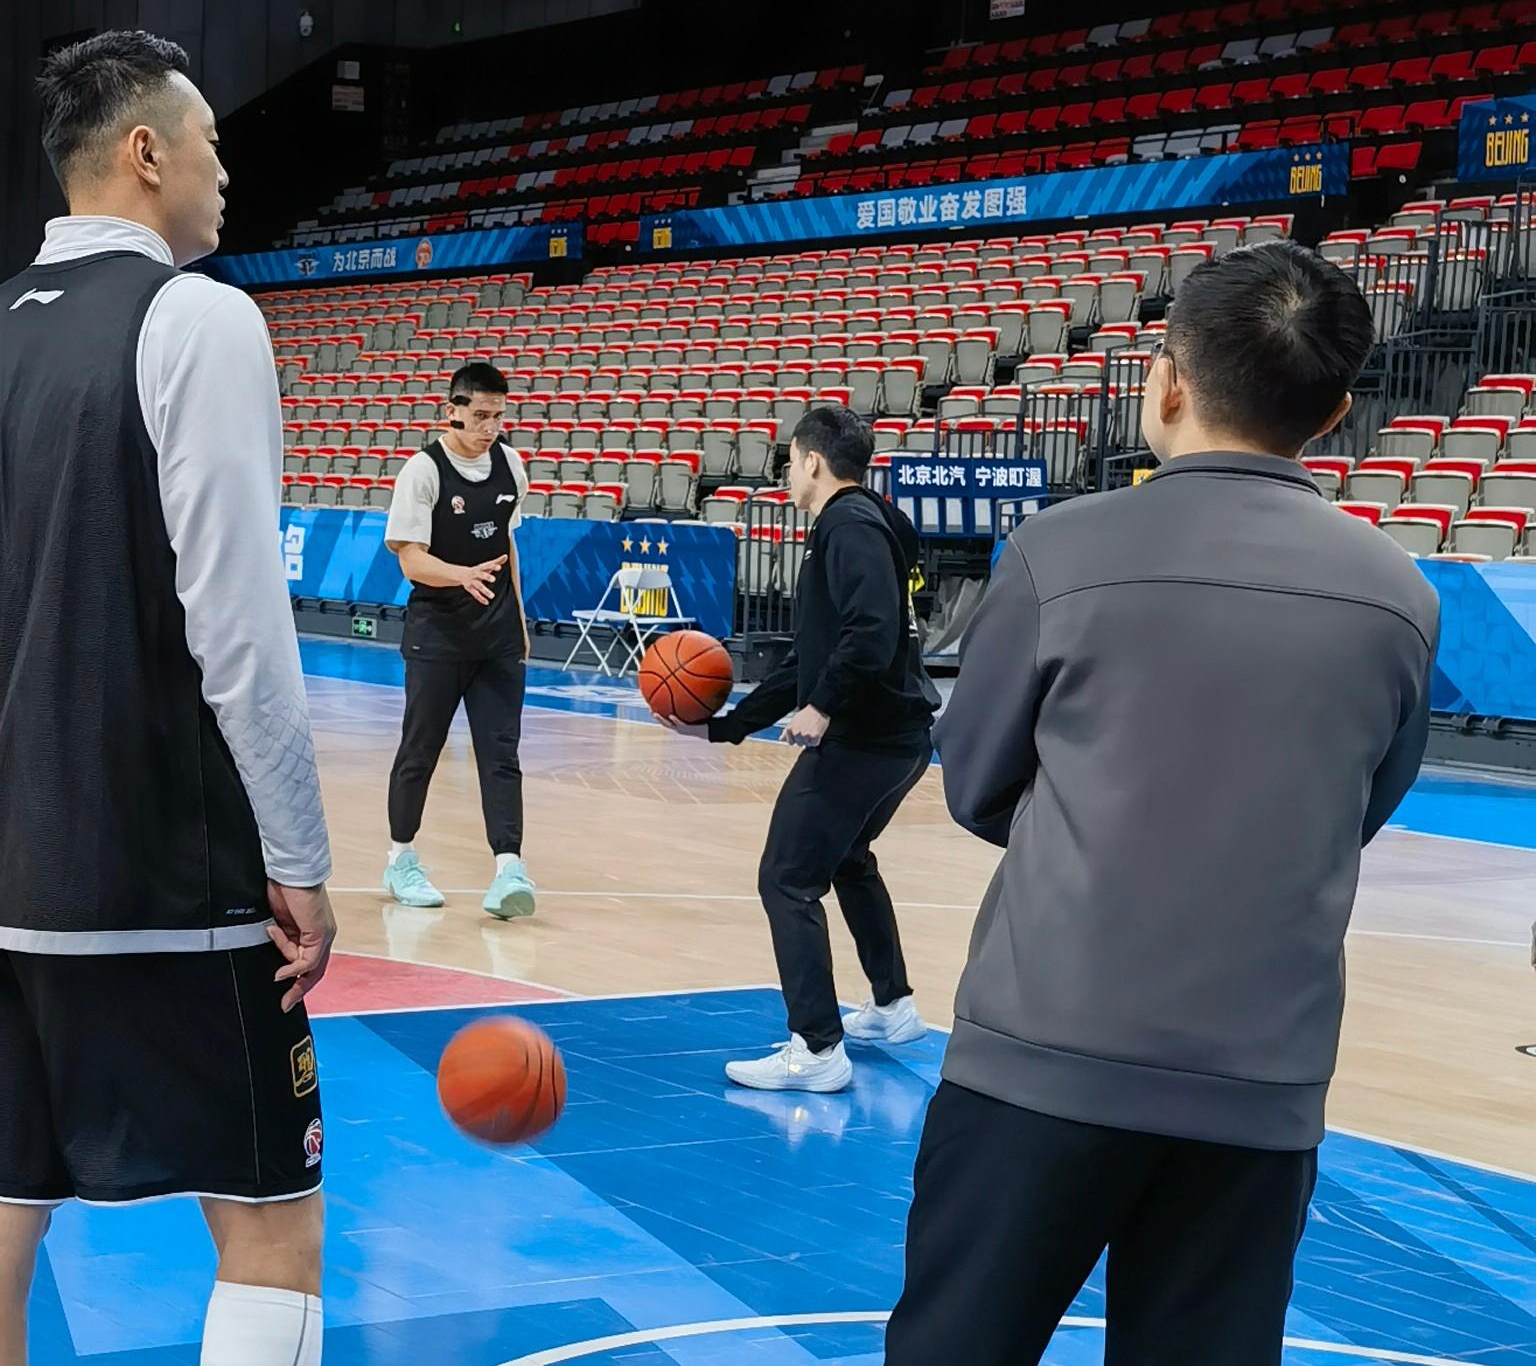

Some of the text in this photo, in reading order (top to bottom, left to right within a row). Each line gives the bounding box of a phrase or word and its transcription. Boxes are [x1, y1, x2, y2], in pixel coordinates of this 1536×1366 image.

[856, 185, 1027, 229] 爱国敬业奋发图强
[331, 246, 398, 272] 为北京而战
[897, 464, 967, 487] 北京北汽
[280, 523, 306, 581] 名
